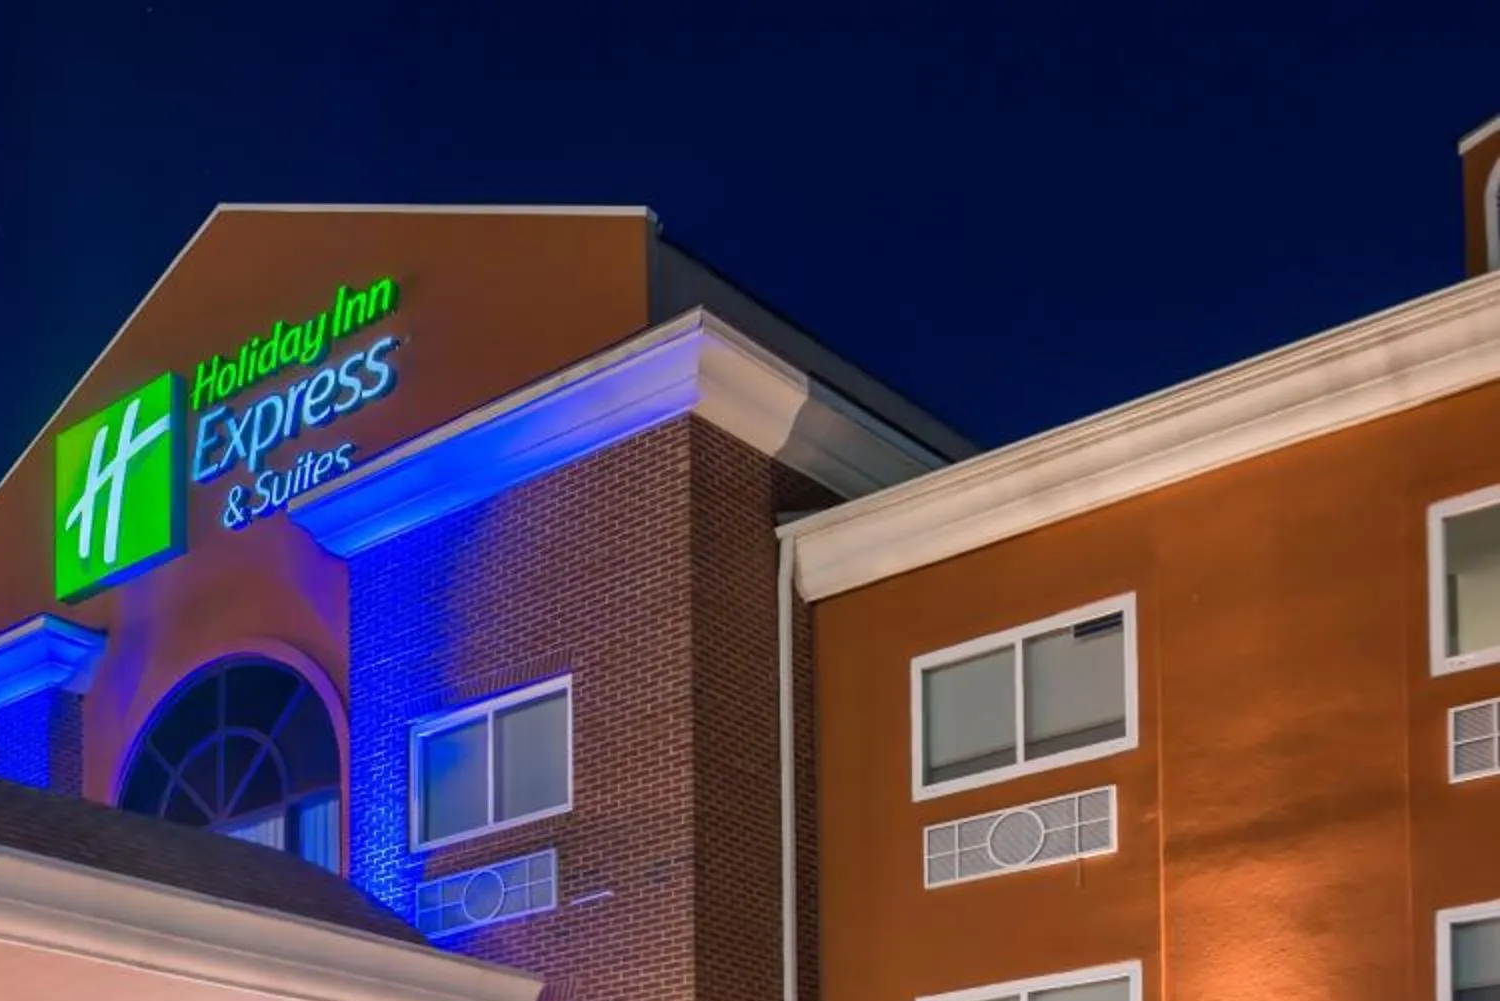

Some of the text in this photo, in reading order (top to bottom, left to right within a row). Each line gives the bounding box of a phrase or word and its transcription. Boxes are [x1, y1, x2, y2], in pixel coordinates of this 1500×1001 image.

[191, 276, 394, 409] Holiday Inn
[191, 336, 395, 482] Express
[222, 442, 353, 528] & Suites
